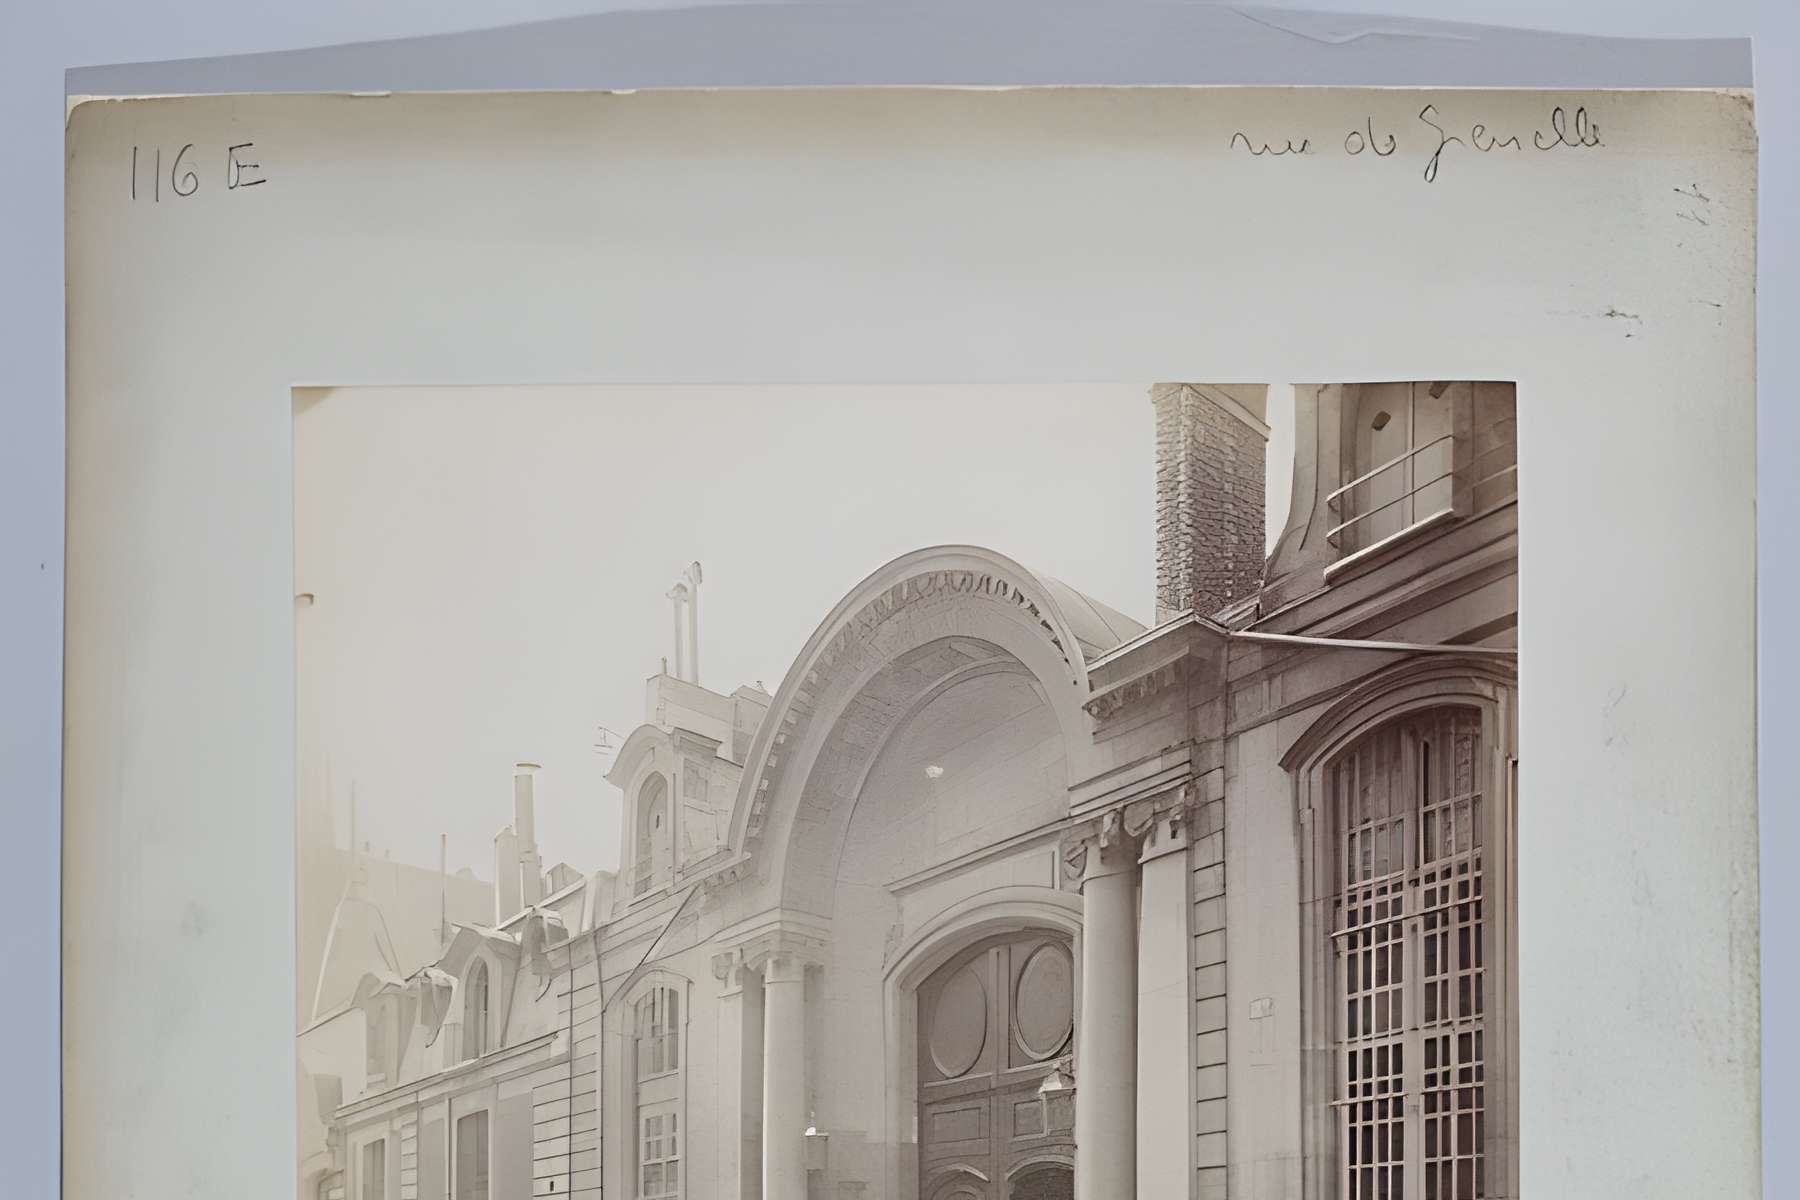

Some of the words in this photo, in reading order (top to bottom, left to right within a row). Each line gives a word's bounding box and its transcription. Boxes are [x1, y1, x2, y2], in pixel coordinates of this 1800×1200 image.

[1345, 116, 1396, 156] de
[132, 144, 198, 202] 116
[228, 143, 267, 190] E
